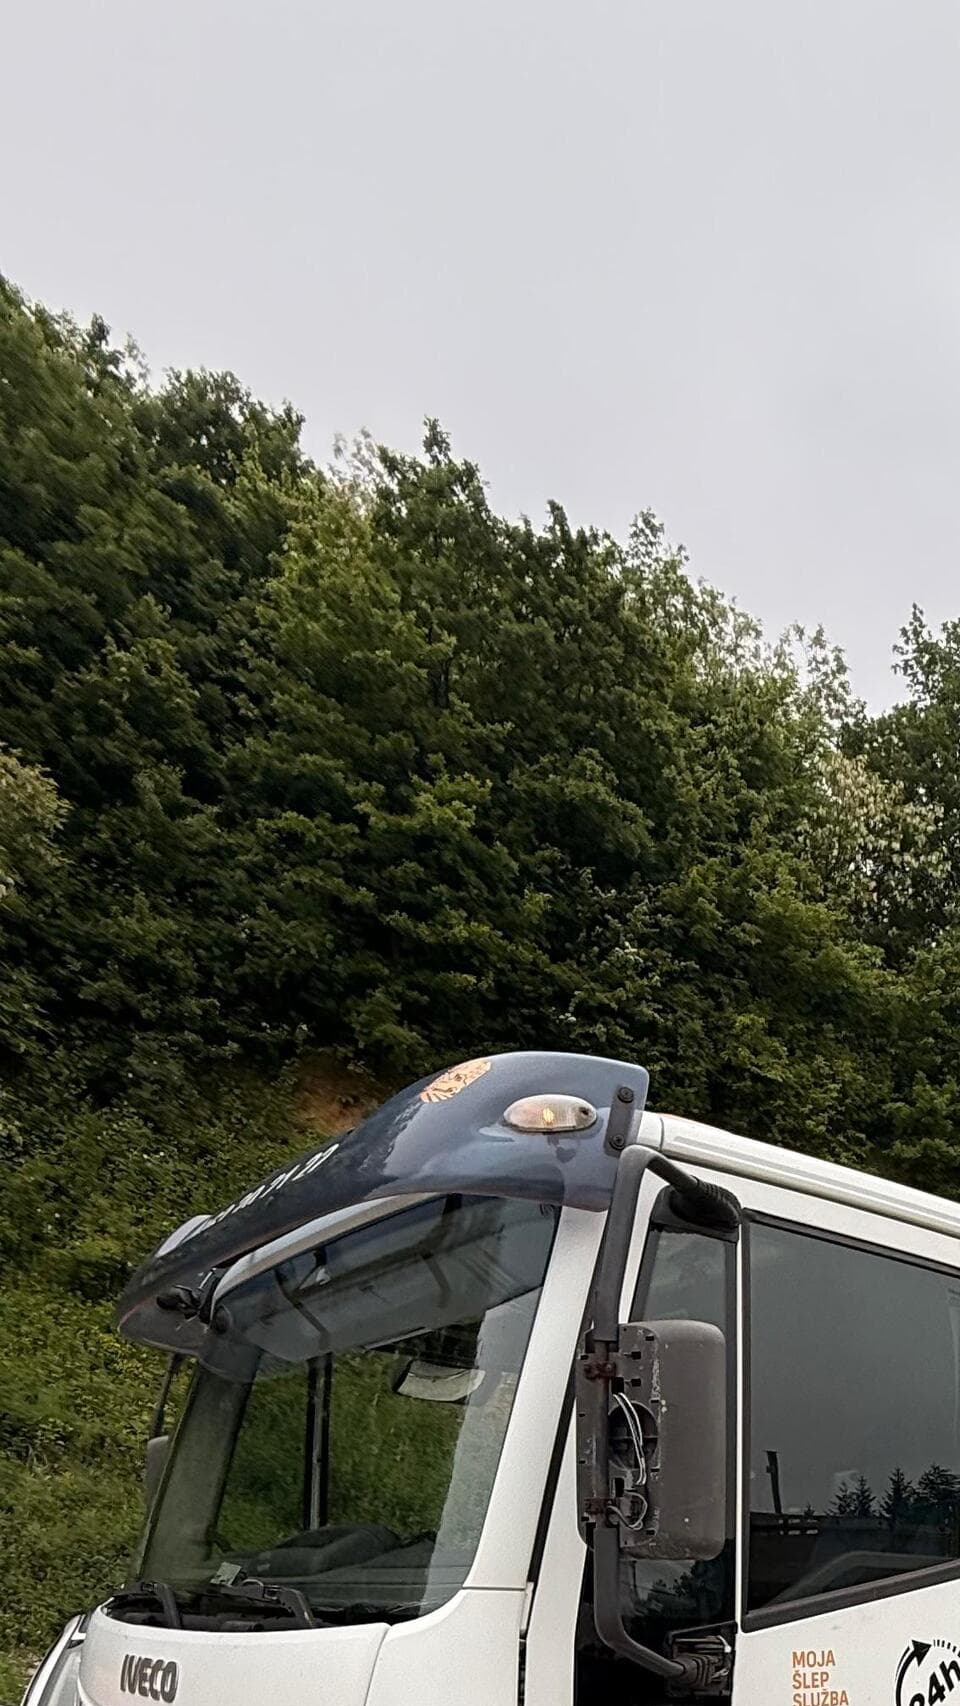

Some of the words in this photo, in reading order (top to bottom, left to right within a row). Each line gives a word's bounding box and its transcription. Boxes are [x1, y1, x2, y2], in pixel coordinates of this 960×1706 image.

[792, 1650, 836, 1668] MOJA
[119, 1654, 179, 1703] IVECO
[792, 1670, 830, 1690] ŠLEP
